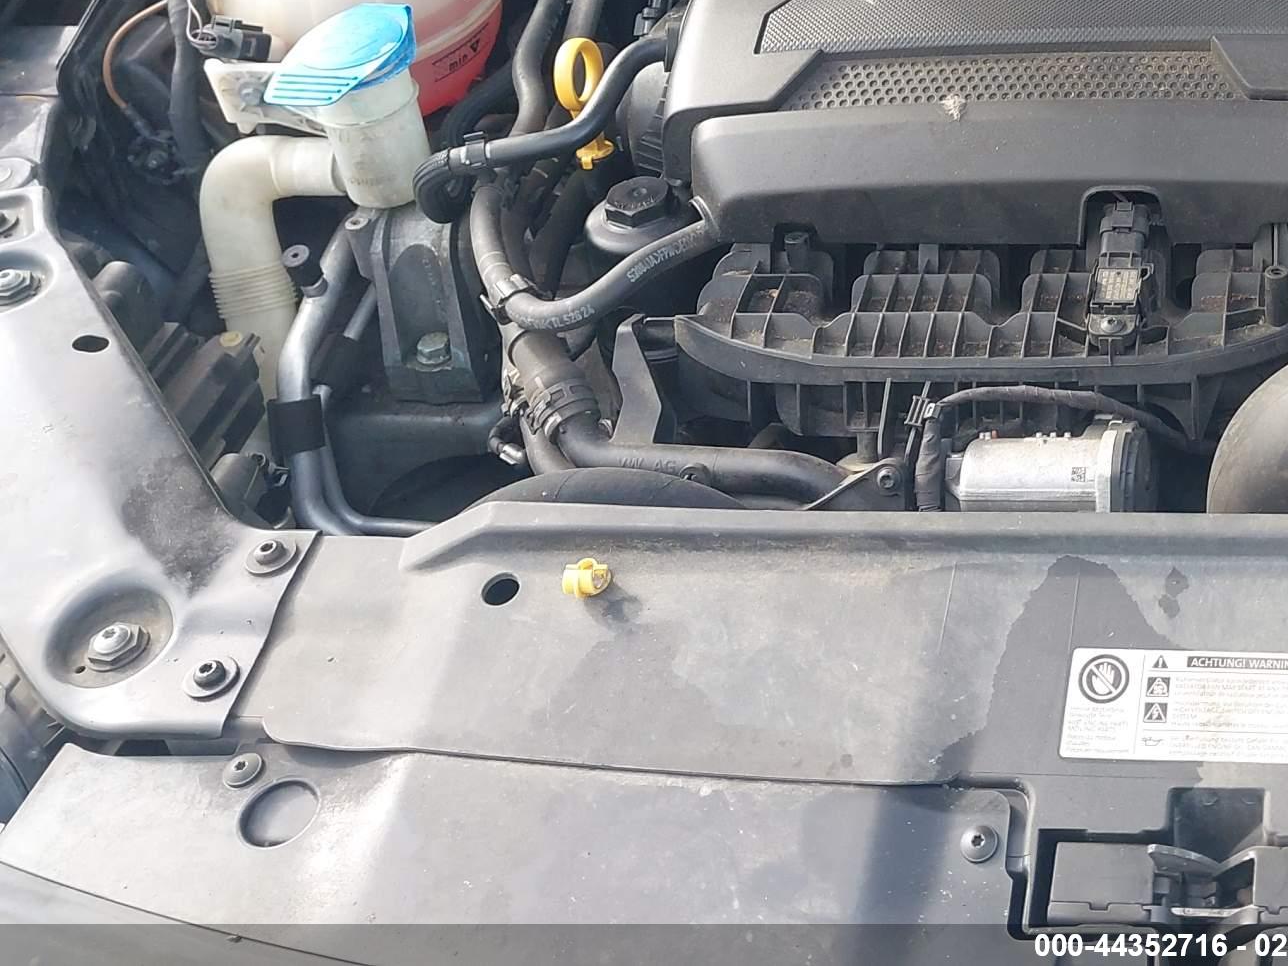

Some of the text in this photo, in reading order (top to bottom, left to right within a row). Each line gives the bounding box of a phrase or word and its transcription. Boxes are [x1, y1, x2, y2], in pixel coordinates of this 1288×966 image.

[448, 54, 469, 72] min
[654, 457, 676, 472] AG
[1190, 657, 1247, 669] ACHTUNG!
